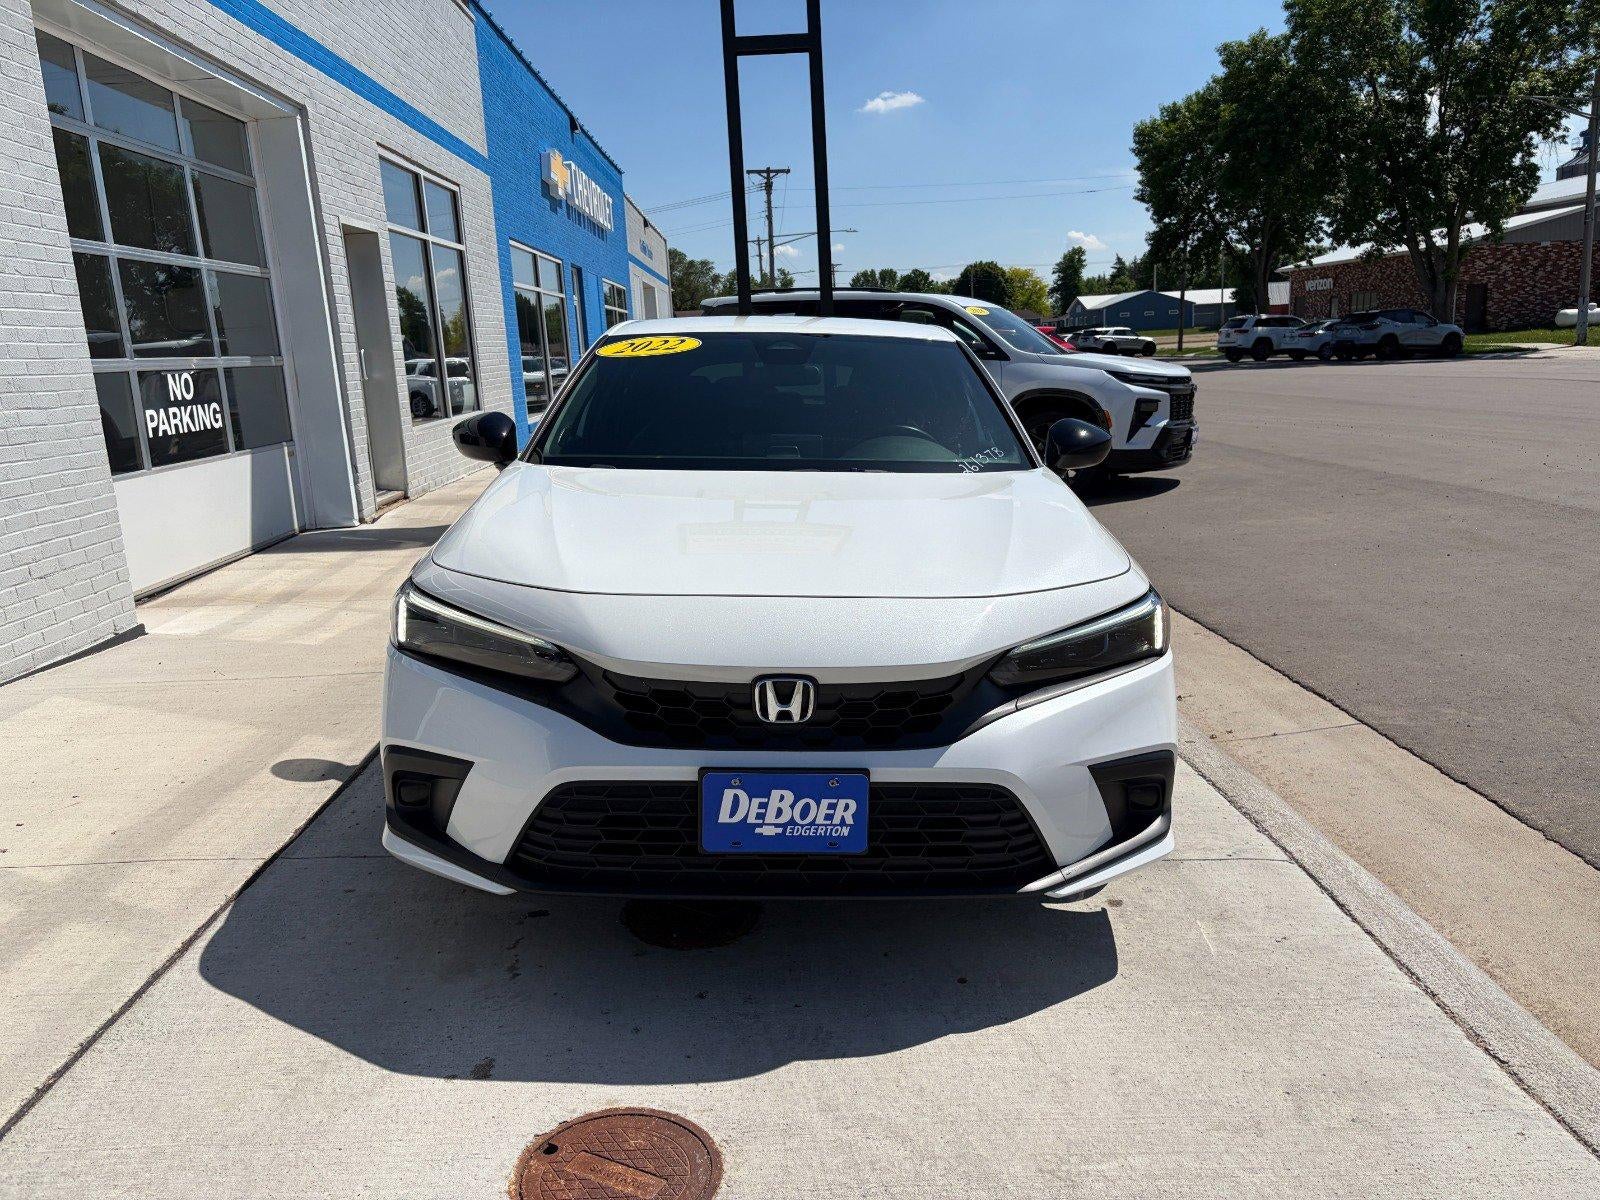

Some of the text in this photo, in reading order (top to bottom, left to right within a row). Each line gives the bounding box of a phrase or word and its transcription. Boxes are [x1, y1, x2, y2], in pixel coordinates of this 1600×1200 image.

[611, 339, 687, 354] 2022
[167, 372, 194, 401] NO
[145, 402, 223, 438] PARKING
[785, 825, 850, 837] EDGERTON
